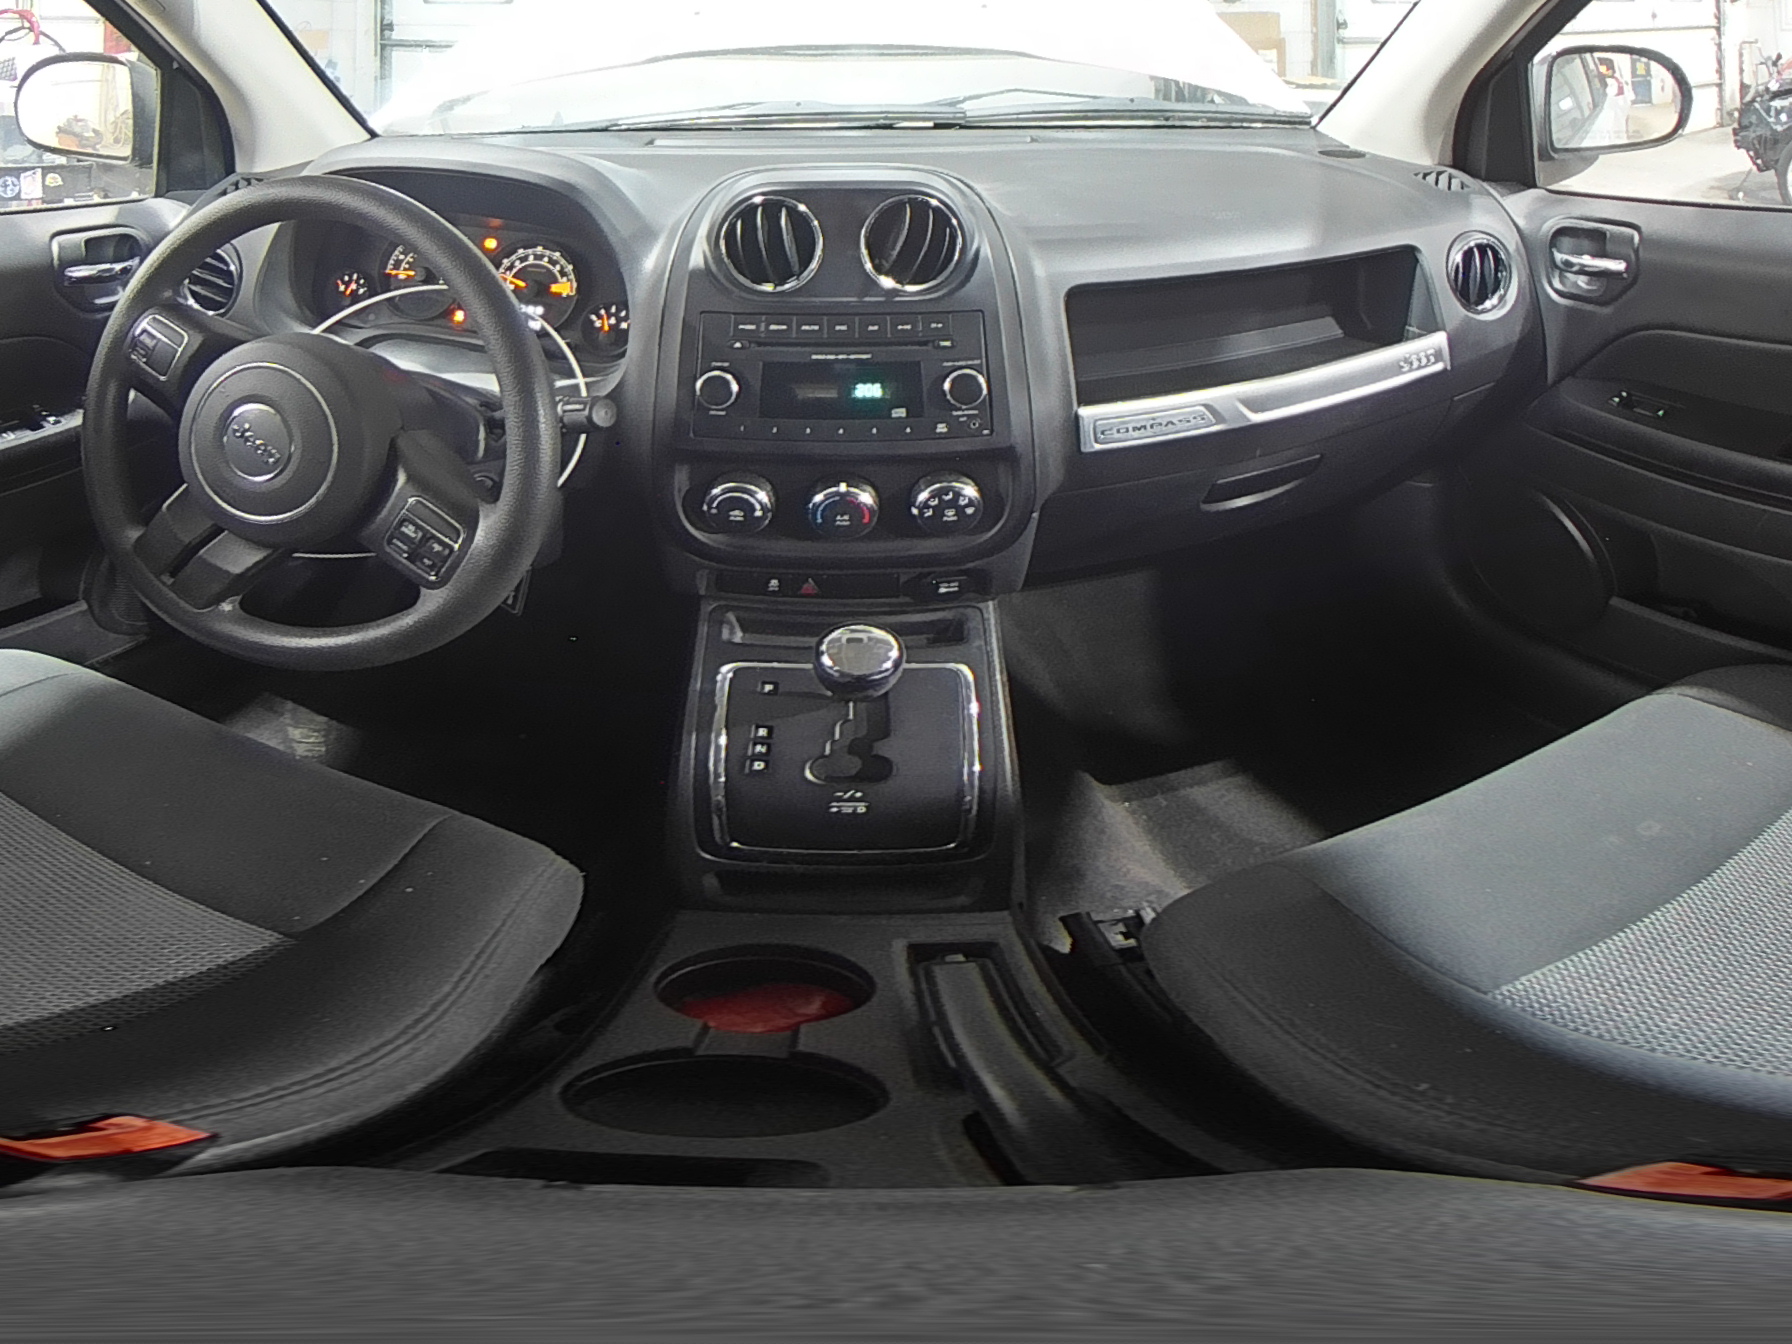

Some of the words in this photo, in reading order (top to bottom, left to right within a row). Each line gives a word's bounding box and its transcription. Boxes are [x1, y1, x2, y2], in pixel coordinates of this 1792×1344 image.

[1099, 414, 1206, 439] COMPASS
[763, 684, 775, 693] P
[757, 727, 769, 737] R
[755, 744, 767, 754] N
[752, 761, 766, 770] D
